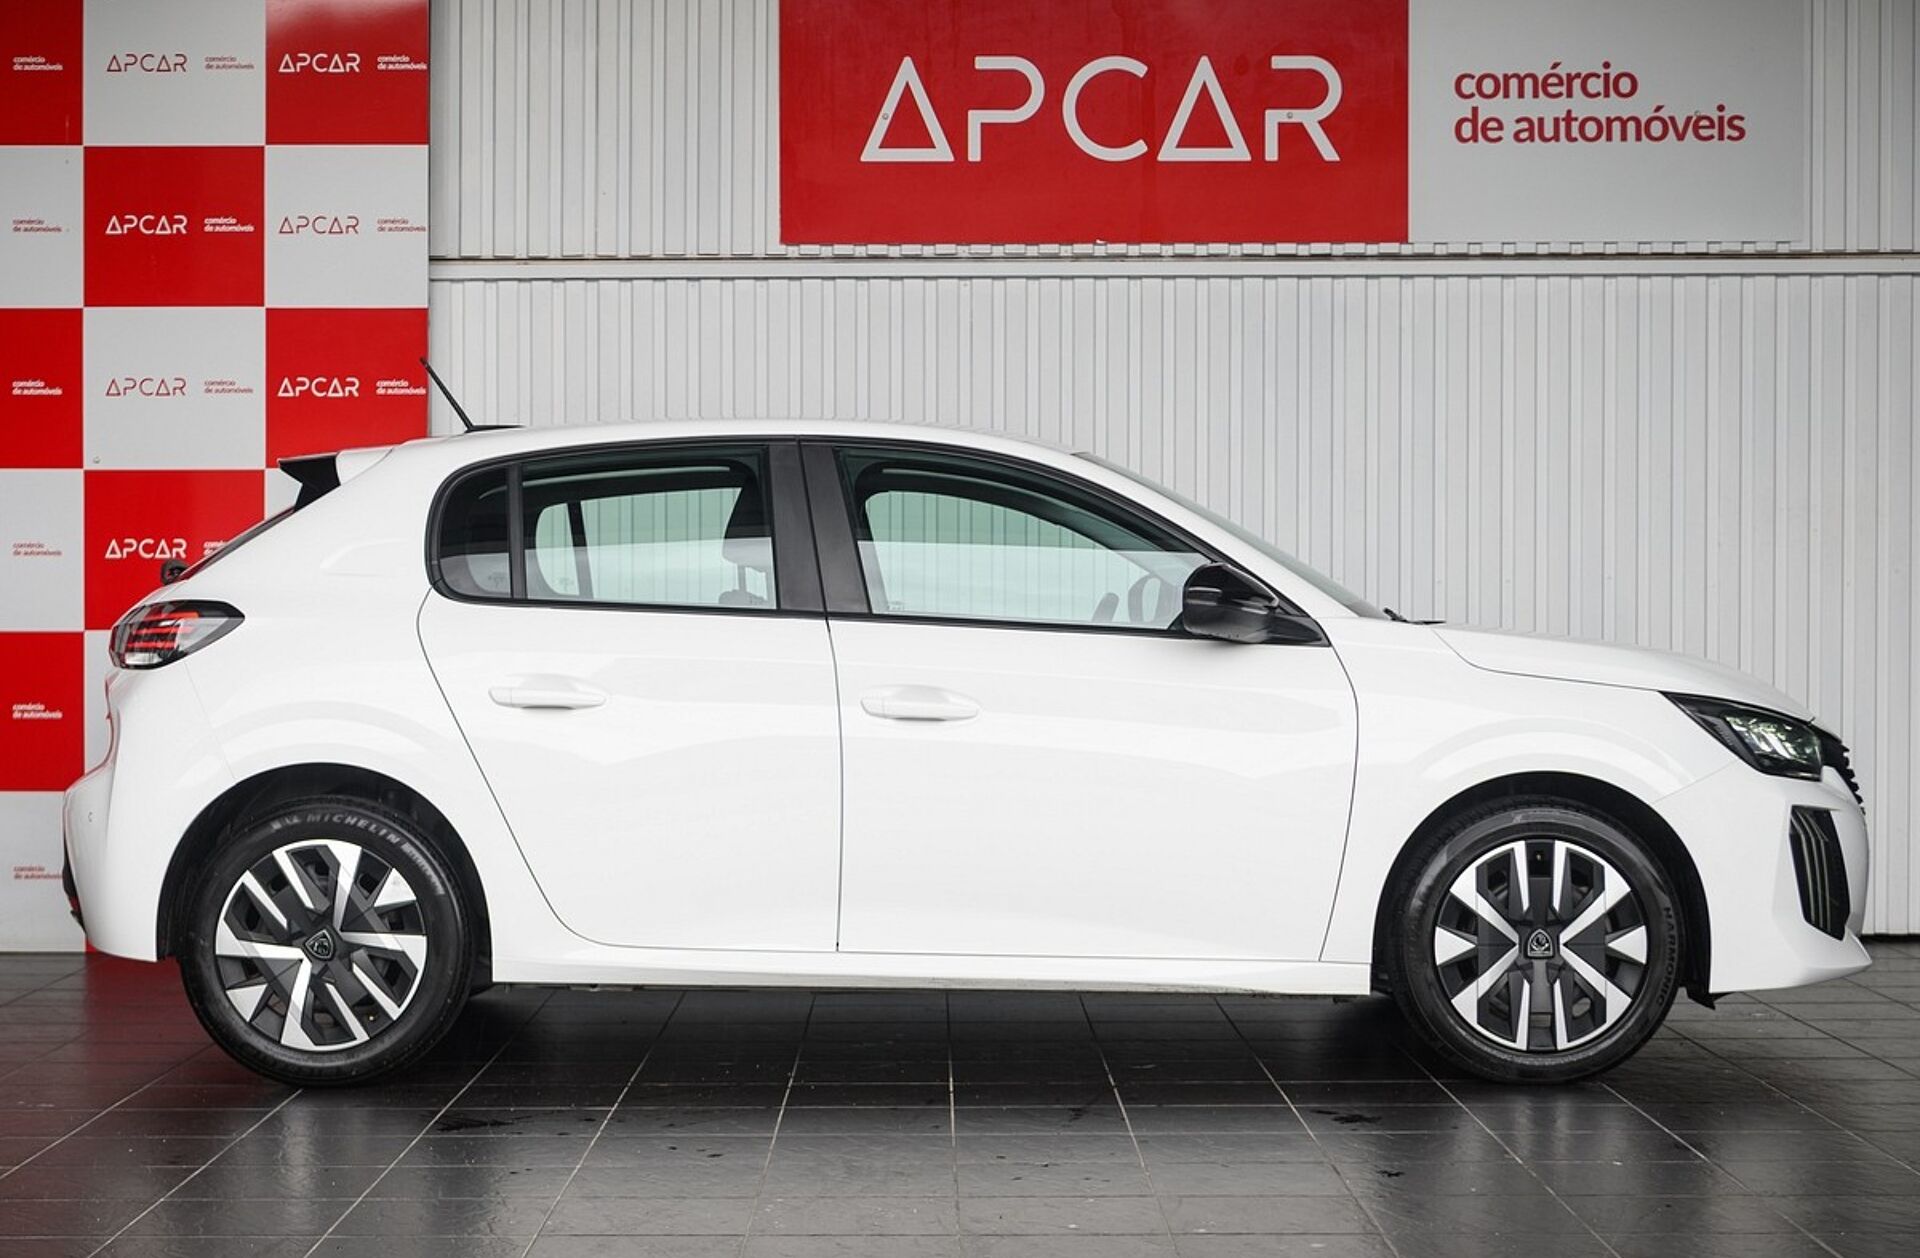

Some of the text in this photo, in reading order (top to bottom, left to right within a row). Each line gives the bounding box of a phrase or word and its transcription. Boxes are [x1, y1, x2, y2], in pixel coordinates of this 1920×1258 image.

[107, 53, 187, 73] APCAR
[279, 53, 360, 73] APCAR
[1454, 61, 1637, 100] comércio
[859, 56, 1343, 162] APCAR
[1454, 104, 1746, 144] de automóveis
[106, 215, 187, 235] APCAR
[279, 215, 360, 235] APCAR
[106, 378, 186, 397] APCAR
[278, 377, 360, 397] APCAR
[105, 538, 187, 559] APCAR
[307, 812, 400, 845] MICHELIN
